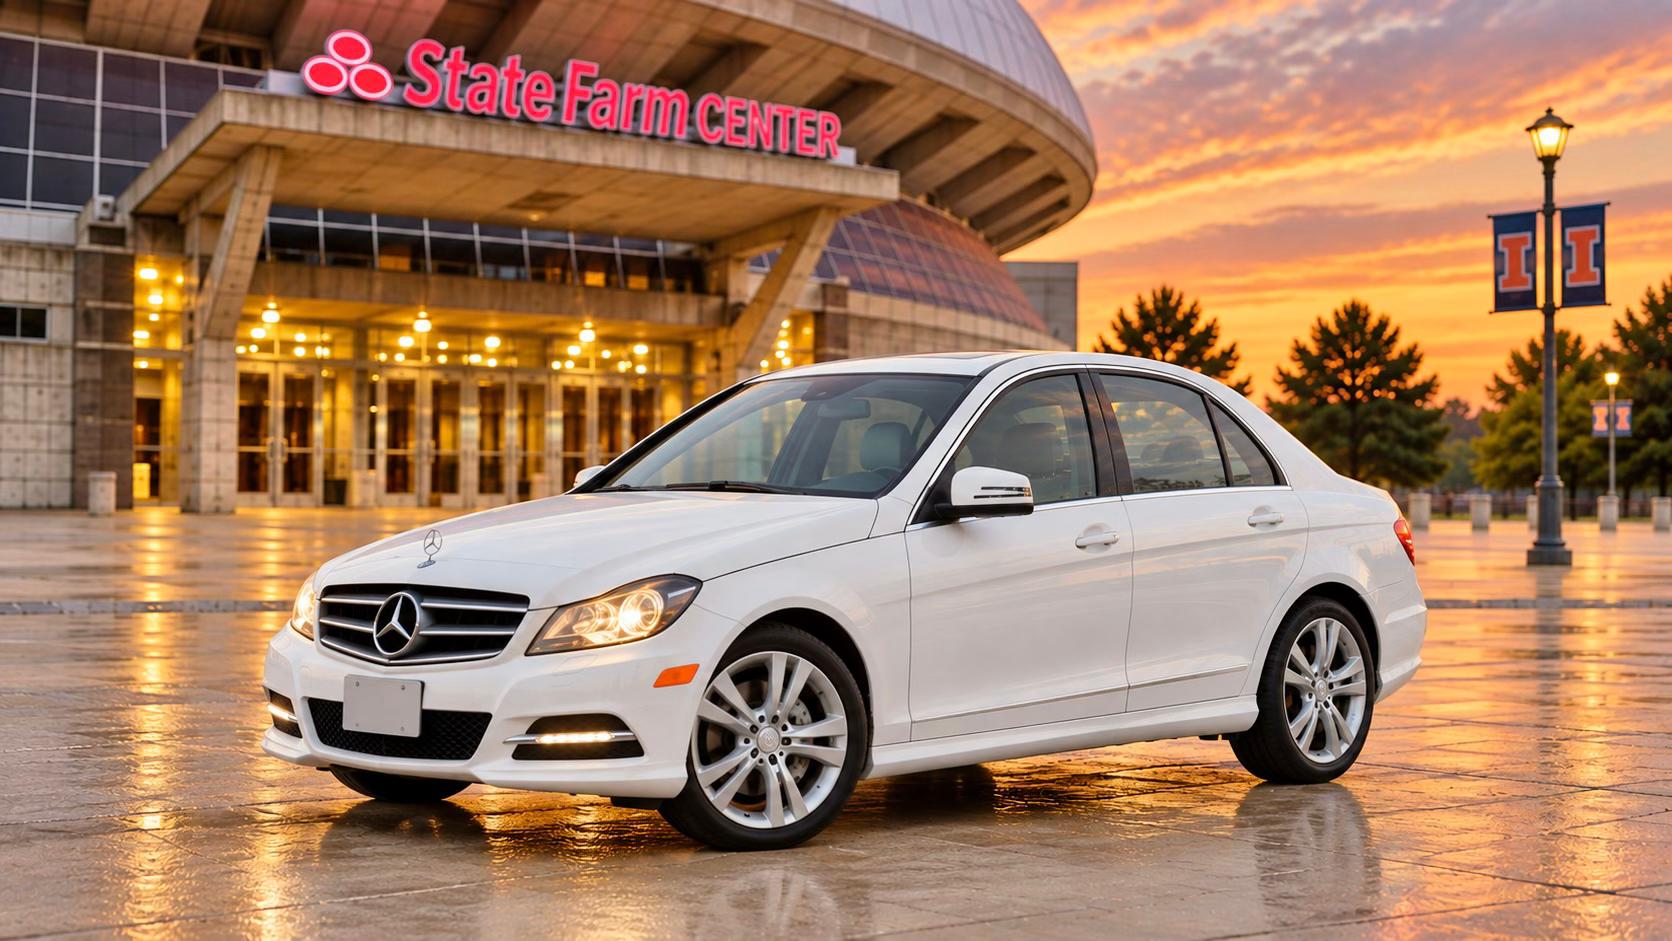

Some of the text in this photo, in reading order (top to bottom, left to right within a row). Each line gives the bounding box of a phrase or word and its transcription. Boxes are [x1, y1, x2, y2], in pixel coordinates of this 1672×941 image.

[404, 38, 842, 158] State Farm CENTER
[1498, 231, 1532, 292] I
[1565, 224, 1600, 288] I
